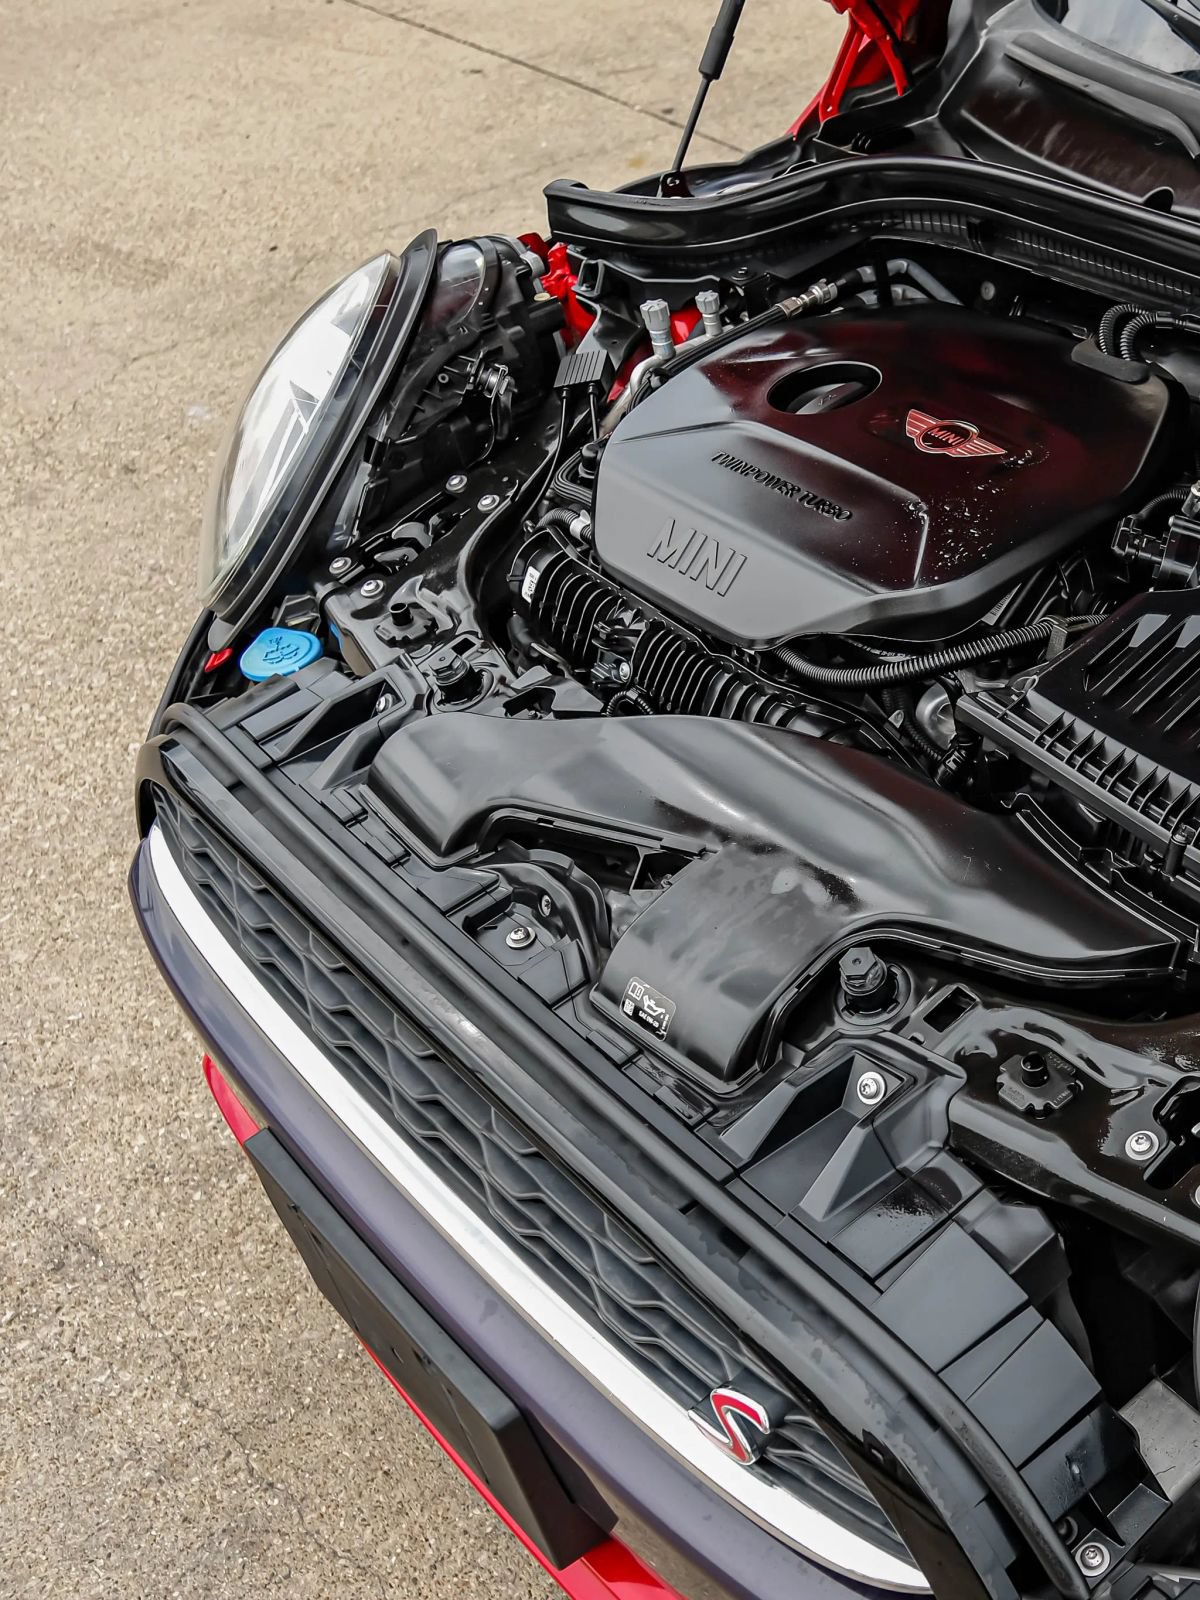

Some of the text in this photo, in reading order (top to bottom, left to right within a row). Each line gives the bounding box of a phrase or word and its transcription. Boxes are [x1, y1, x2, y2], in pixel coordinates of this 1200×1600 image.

[927, 427, 965, 446] MINI
[711, 450, 853, 522] TWINPOWER TURBO
[645, 516, 748, 598] MINI
[687, 1387, 771, 1466] S
